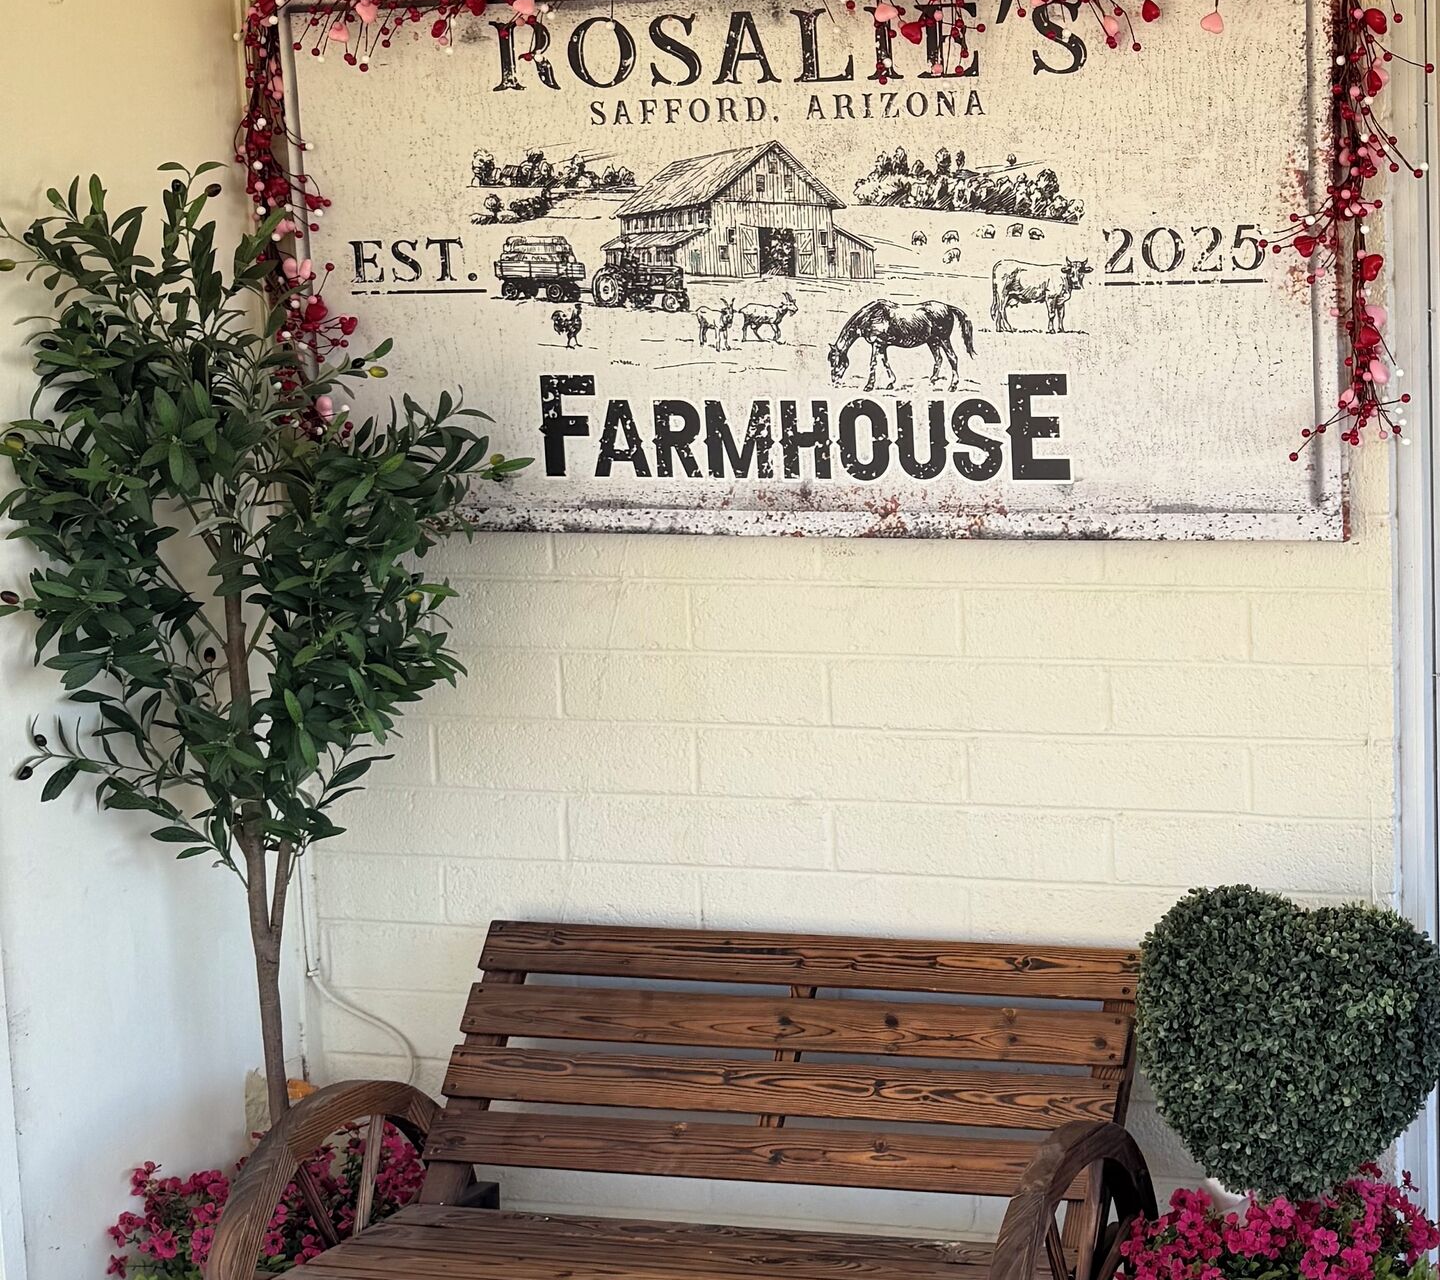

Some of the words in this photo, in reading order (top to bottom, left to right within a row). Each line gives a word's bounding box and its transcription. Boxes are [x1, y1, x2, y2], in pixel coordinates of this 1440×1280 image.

[806, 88, 987, 118] ARIZONA
[348, 236, 478, 284] EST.
[1102, 224, 1267, 273] 2025
[538, 373, 1072, 481] FARMHOUSE
